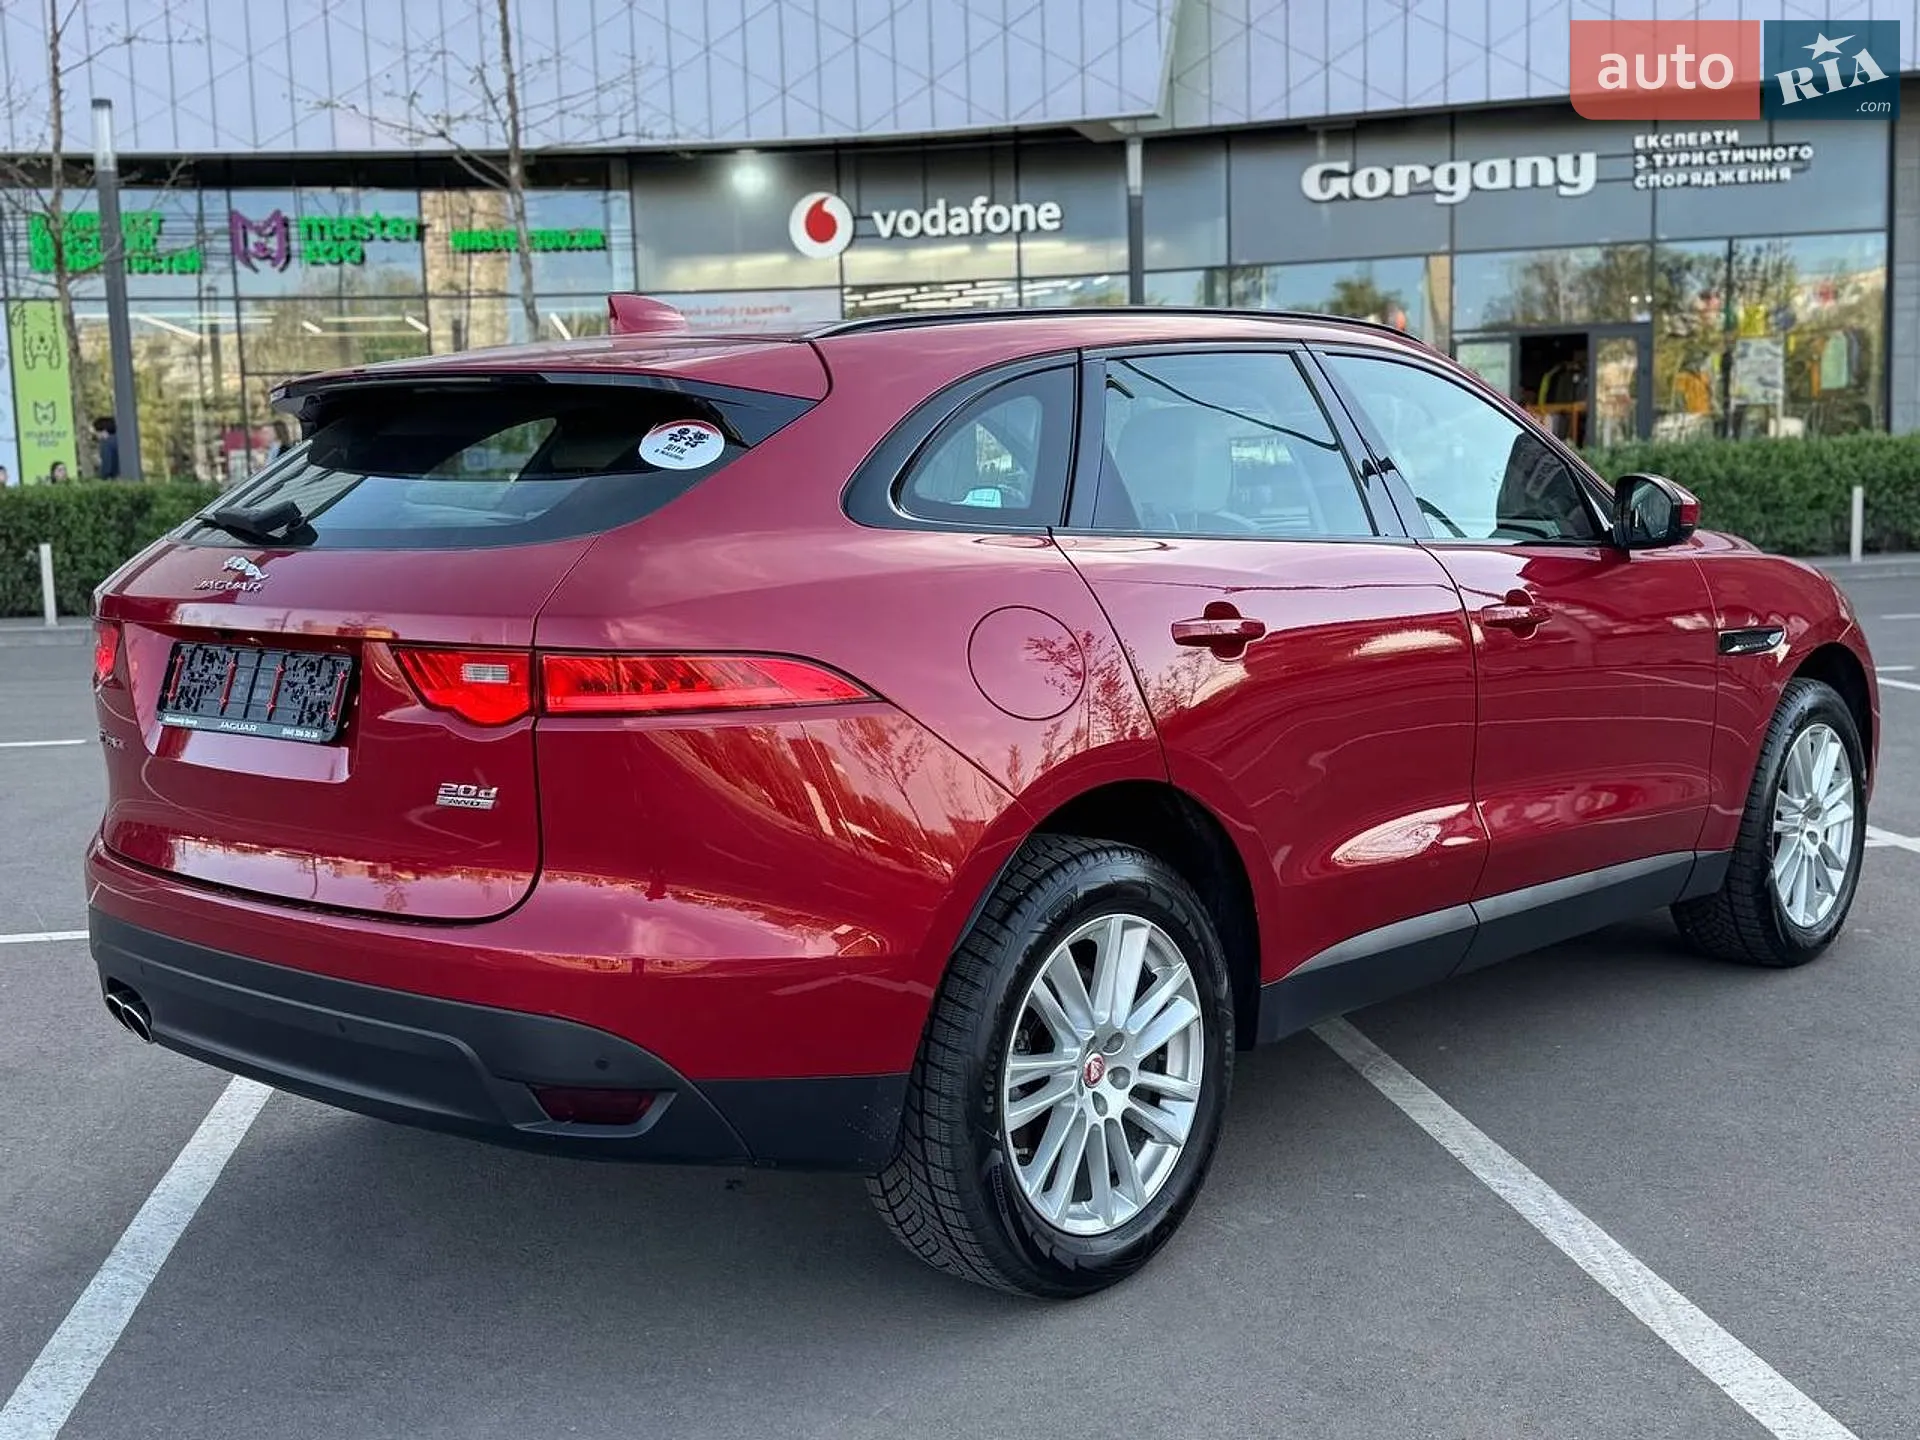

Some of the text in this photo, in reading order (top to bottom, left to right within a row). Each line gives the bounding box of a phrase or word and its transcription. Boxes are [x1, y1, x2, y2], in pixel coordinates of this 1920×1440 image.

[1634, 129, 1740, 150] ЕКСПЕРТИ
[1634, 145, 1814, 169] З ТУРИСТИЧНОГО
[1300, 152, 1597, 204] Gorgany
[1634, 166, 1793, 189] СПОРЯДЖЕННЯ
[300, 212, 420, 241] master
[872, 195, 1062, 239] vodafone
[194, 579, 263, 593] JAGUAR
[219, 720, 259, 733] JAGUAR
[438, 782, 499, 799] 20d
